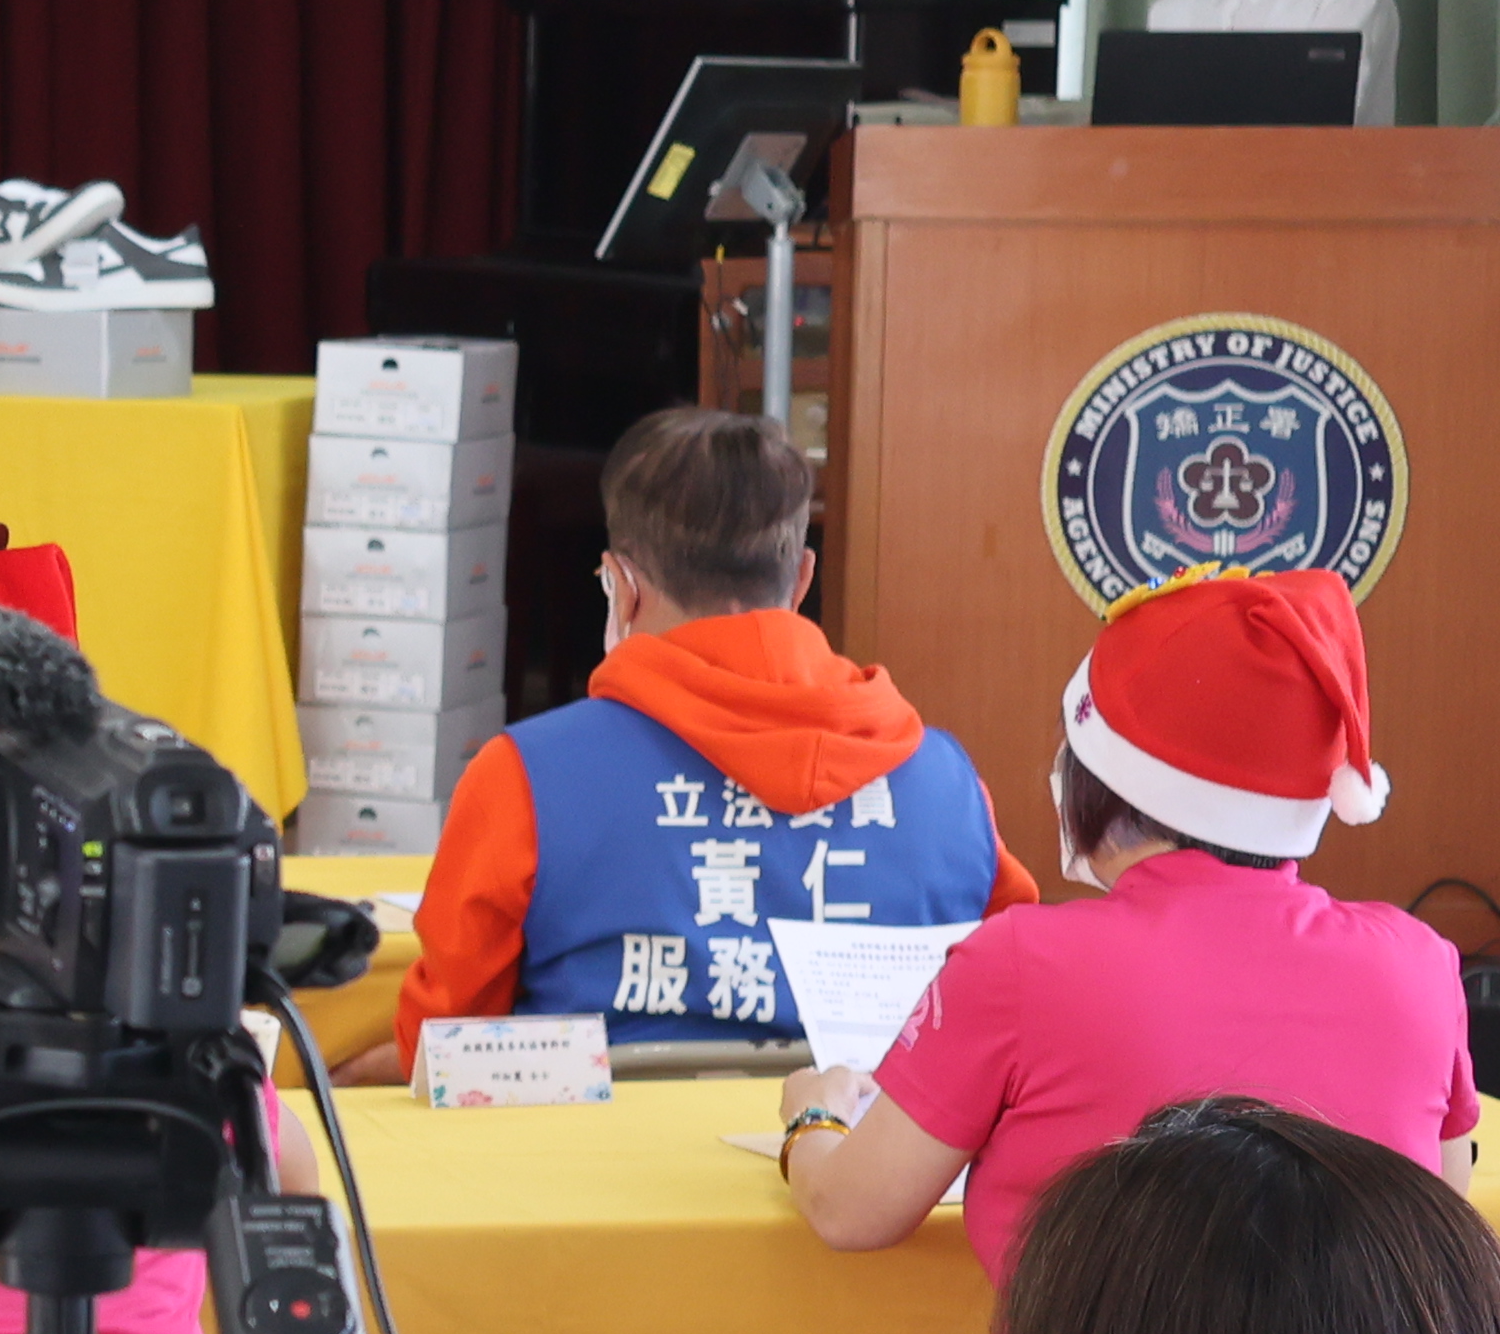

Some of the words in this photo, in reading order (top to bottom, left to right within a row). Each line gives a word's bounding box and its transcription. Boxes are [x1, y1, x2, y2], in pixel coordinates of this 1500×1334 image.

[1074, 333, 1216, 441] MINISTRY
[1226, 332, 1273, 360] OF
[1278, 345, 1381, 445] JUSTICE
[1155, 403, 1301, 441] 矯正署
[690, 838, 872, 929] 黃仁
[612, 933, 778, 1023] 服務
